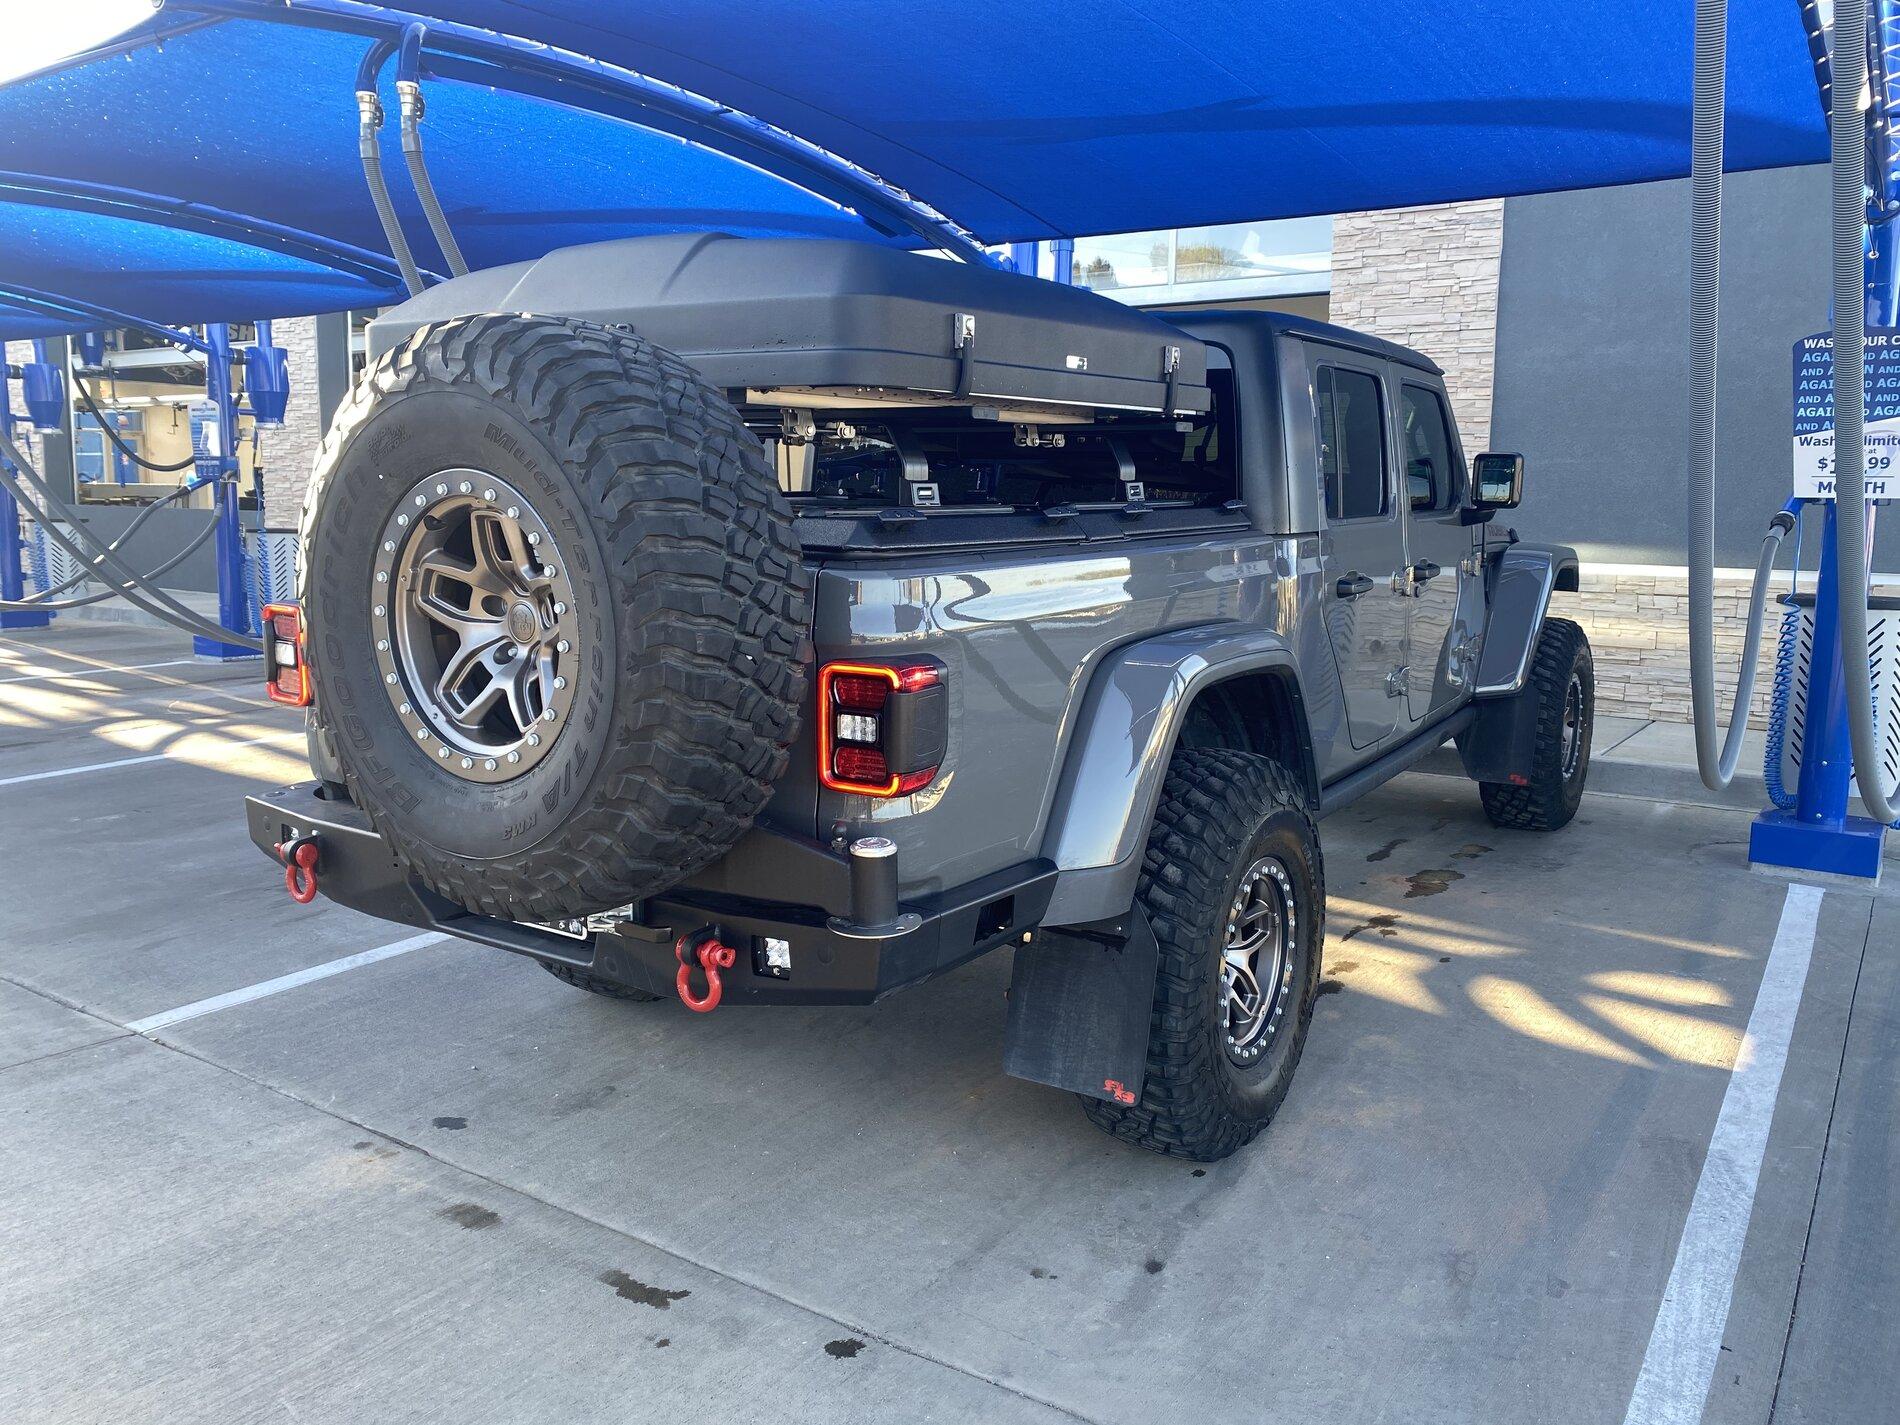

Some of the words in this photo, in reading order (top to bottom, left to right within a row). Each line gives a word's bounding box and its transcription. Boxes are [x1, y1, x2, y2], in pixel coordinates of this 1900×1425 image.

[1803, 338, 1834, 349] WAS
[1800, 368, 1824, 376] AND
[1799, 379, 1834, 390] AGAI
[1798, 395, 1821, 404] AND
[1875, 393, 1899, 402] AND
[1796, 407, 1835, 417] AGAI
[1795, 422, 1818, 431] AND
[1818, 481, 1886, 494] MTH
